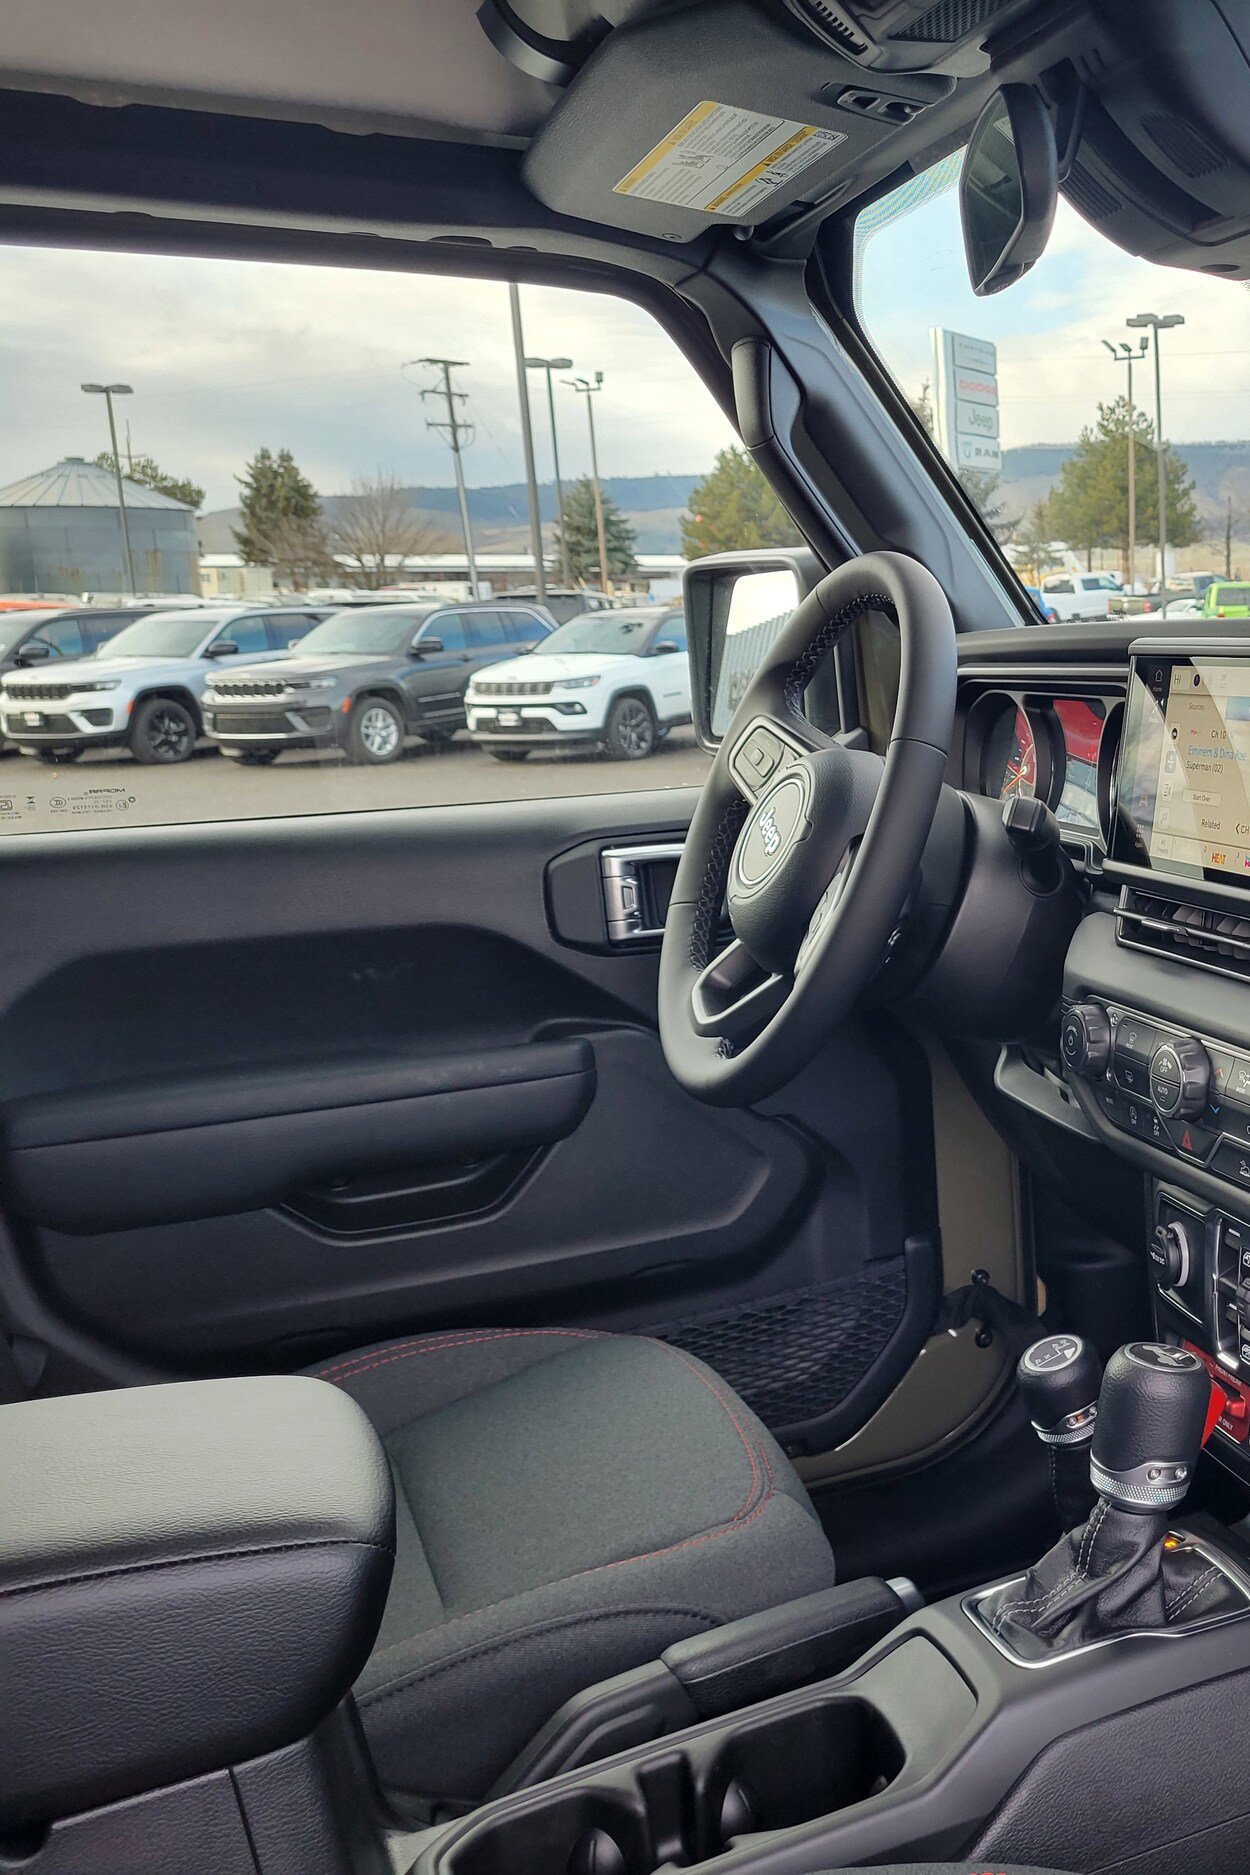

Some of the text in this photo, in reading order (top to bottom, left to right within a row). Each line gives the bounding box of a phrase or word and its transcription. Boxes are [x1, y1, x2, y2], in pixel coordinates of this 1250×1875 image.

[1188, 745, 1213, 758] Eminem
[1219, 749, 1234, 760] Dina
[1186, 761, 1212, 774] Superman
[1201, 819, 1221, 830] Related
[758, 807, 782, 857] Jeep
[1211, 852, 1226, 865] HEAT
